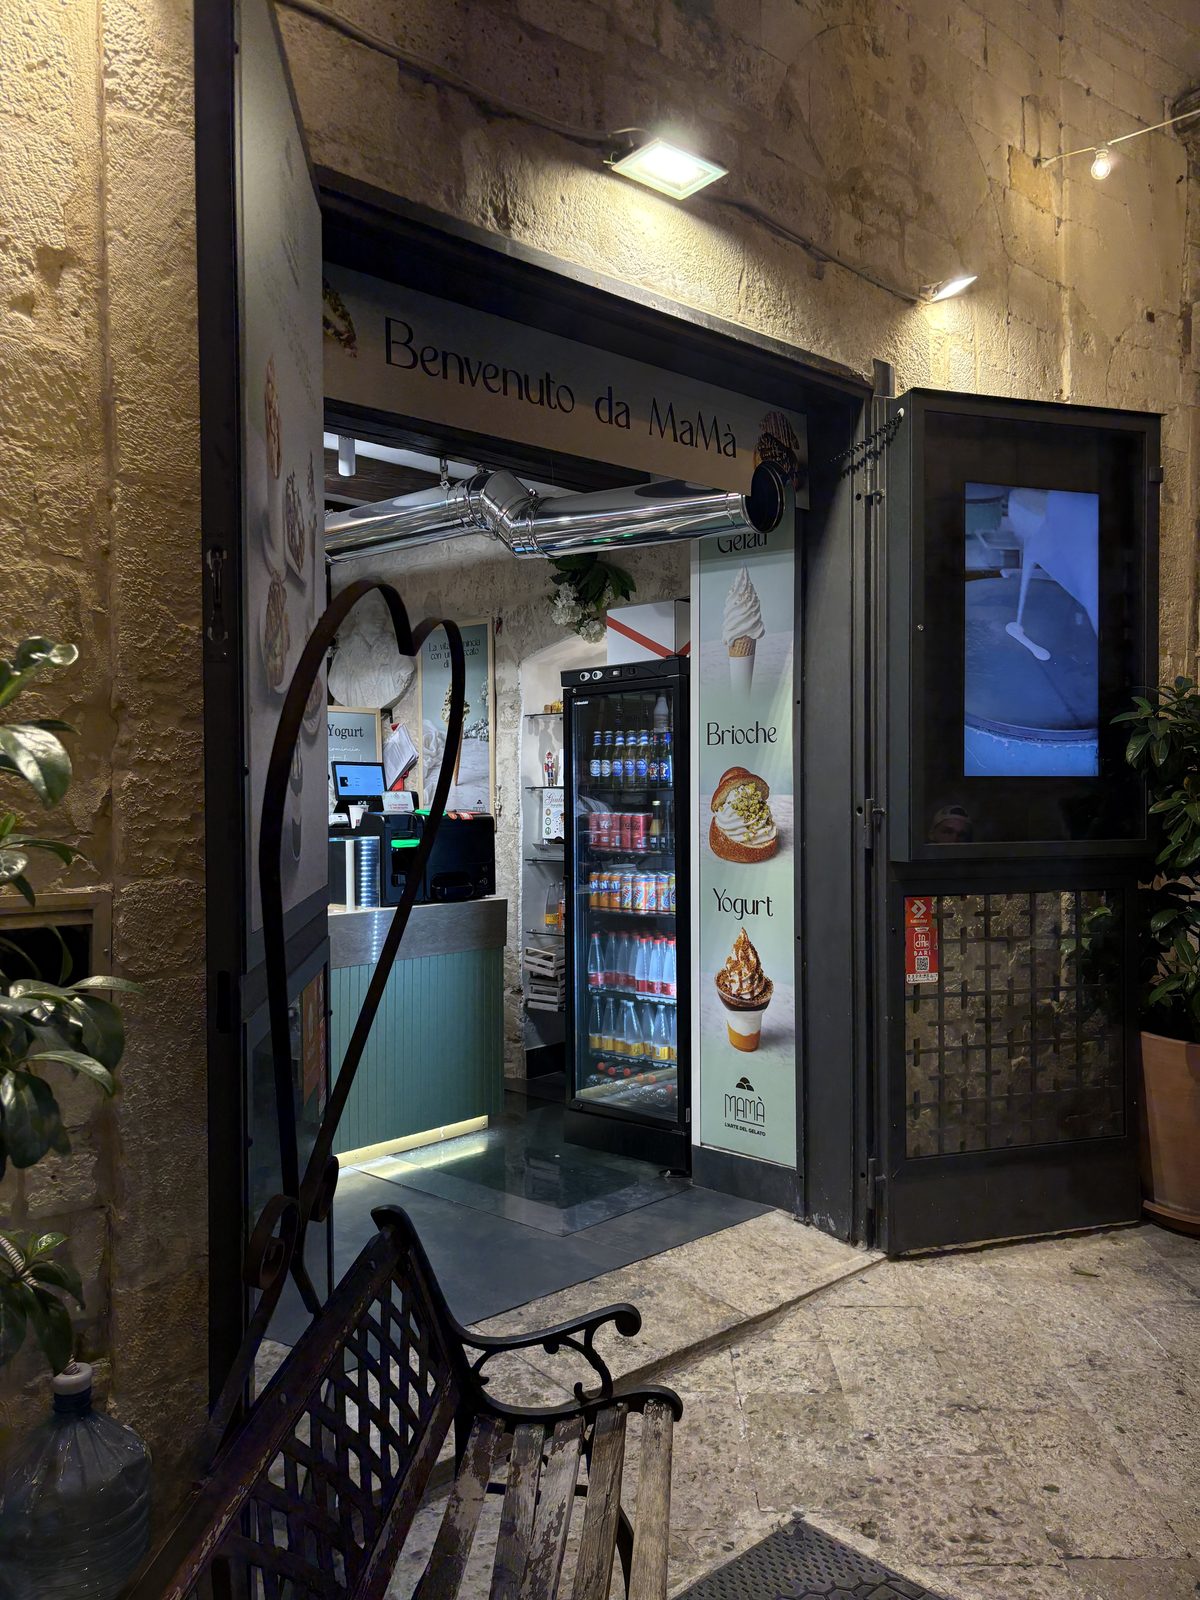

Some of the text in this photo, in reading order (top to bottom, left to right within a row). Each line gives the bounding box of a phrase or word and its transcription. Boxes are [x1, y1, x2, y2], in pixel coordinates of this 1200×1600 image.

[385, 316, 575, 414] Benvenuto
[595, 386, 631, 430] da
[648, 397, 737, 459] MaMà
[327, 723, 364, 740] Yogurt
[706, 721, 778, 746] Brioche
[712, 887, 774, 921] Yogurt
[724, 1093, 765, 1123] MAMÀ
